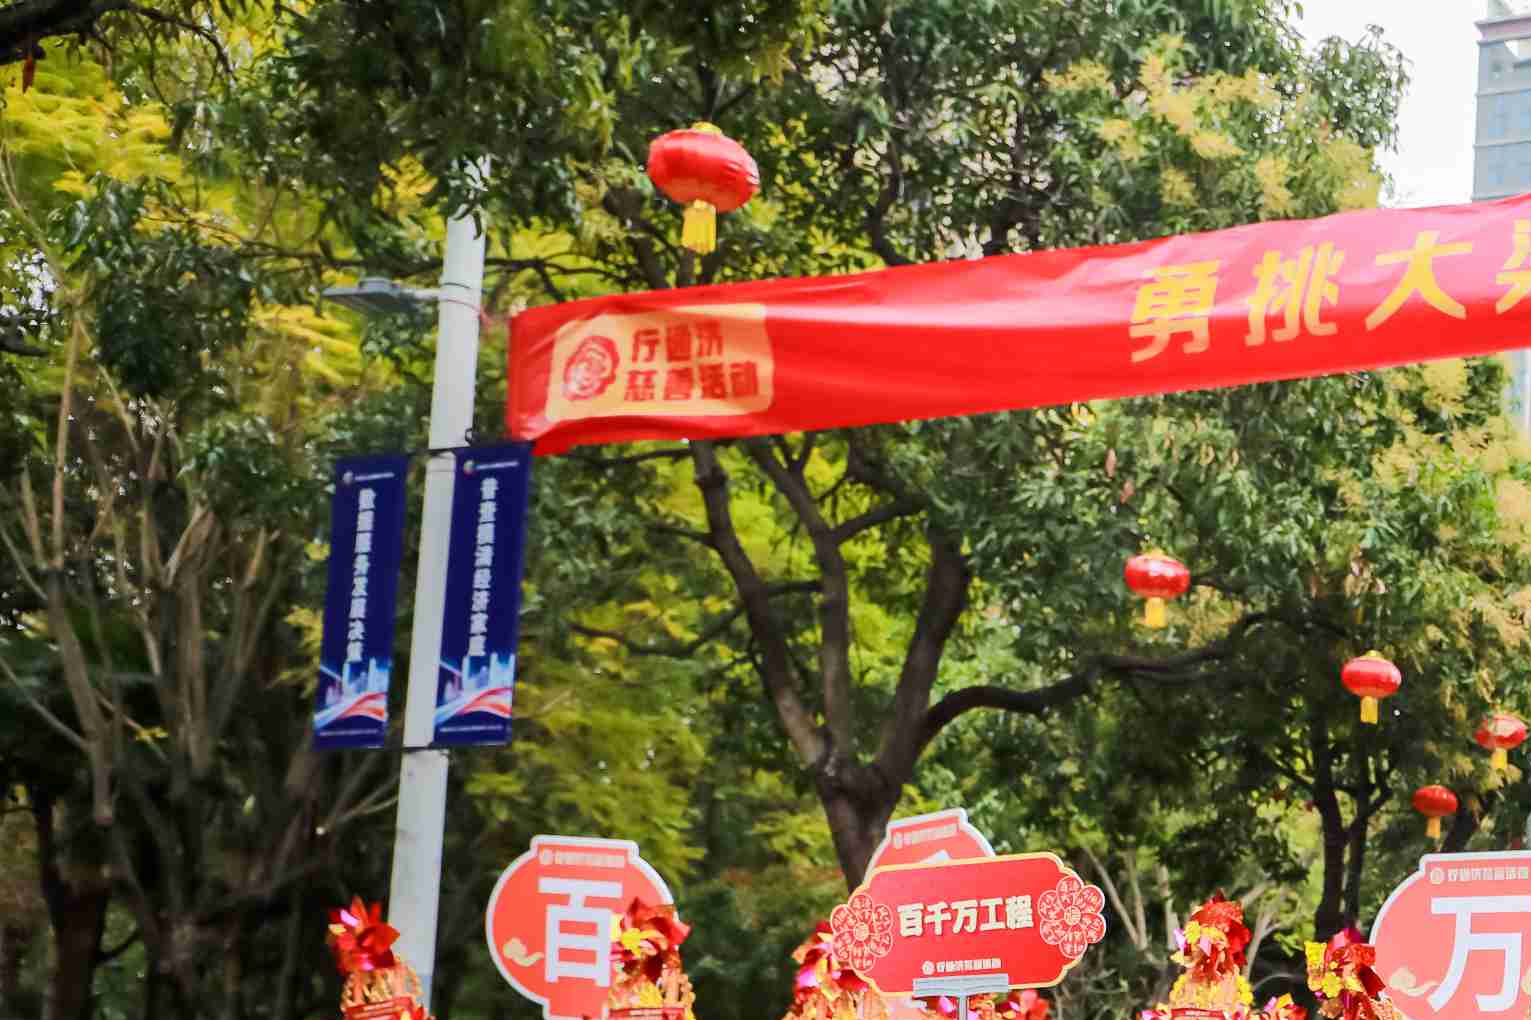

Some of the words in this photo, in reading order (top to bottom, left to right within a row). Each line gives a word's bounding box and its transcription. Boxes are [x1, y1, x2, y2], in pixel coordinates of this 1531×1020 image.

[631, 320, 723, 363] 行通济
[624, 361, 758, 401] 慈善活动
[538, 877, 623, 987] 百
[897, 895, 1034, 937] 百千万工程
[1427, 895, 1531, 1013] 万
